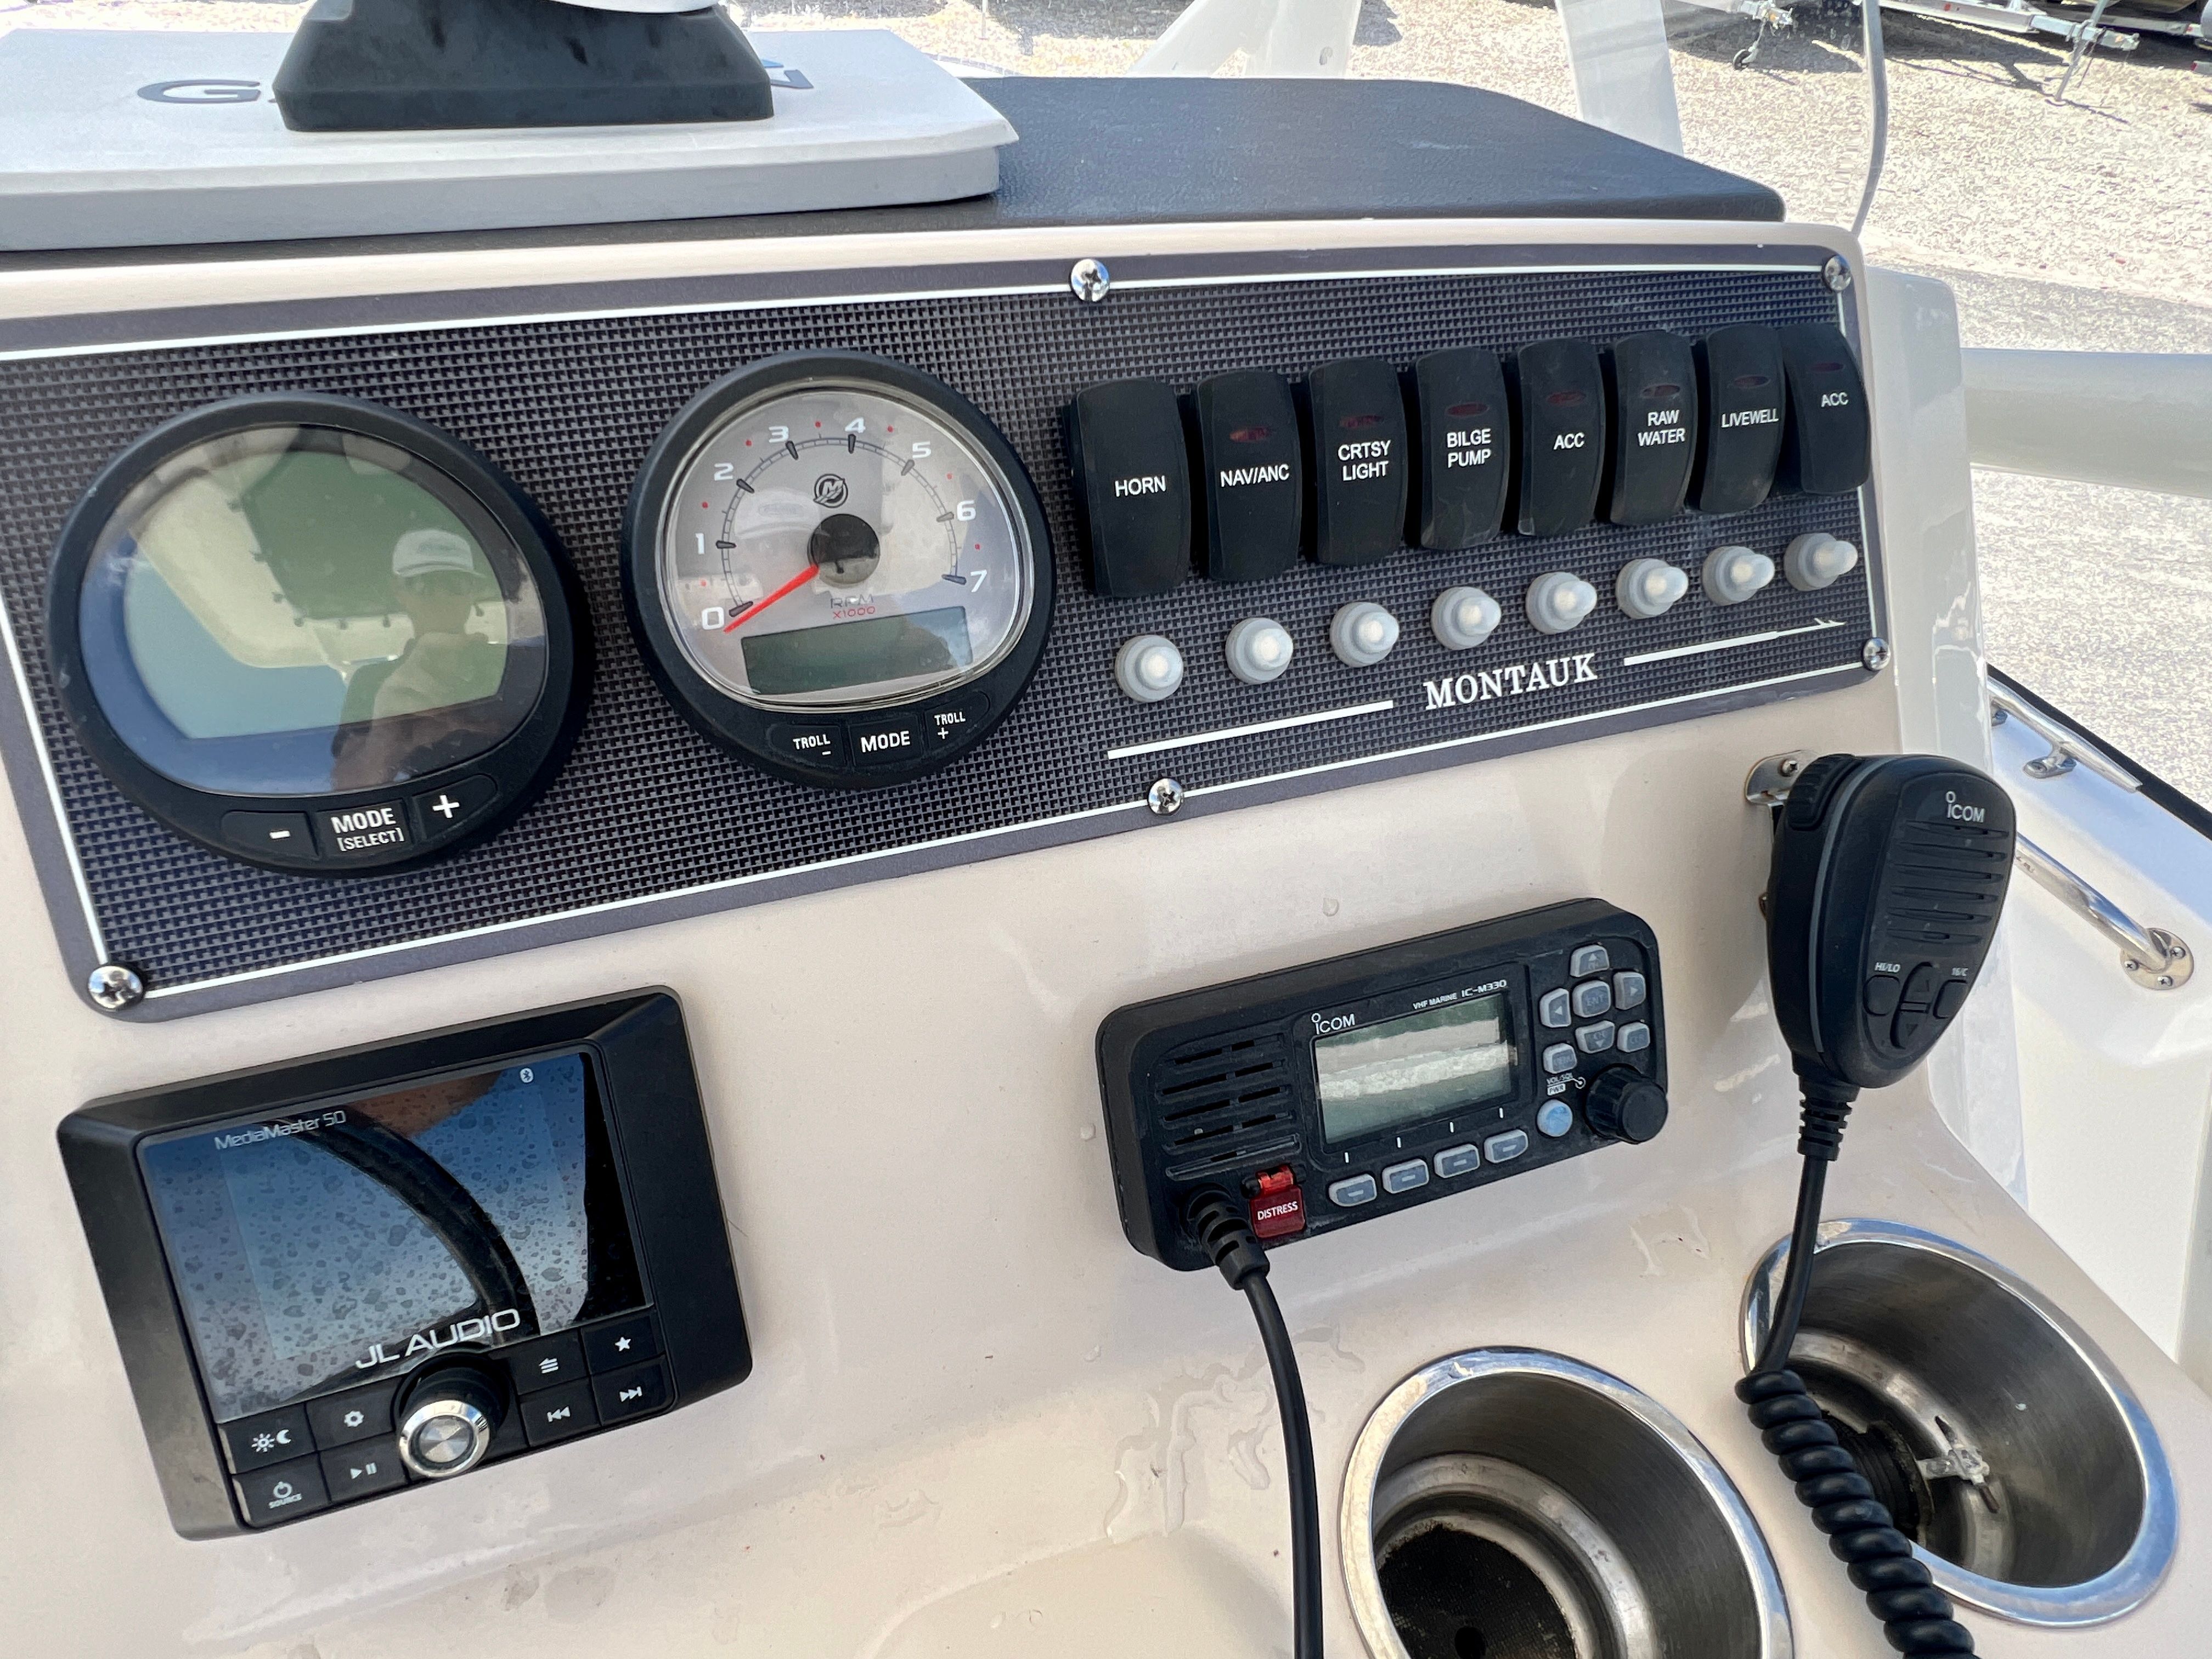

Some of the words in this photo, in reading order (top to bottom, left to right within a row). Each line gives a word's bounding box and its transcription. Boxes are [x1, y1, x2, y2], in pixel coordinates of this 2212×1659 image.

[1821, 392, 1849, 407] ACC
[845, 417, 866, 434] 4
[1647, 409, 1679, 427] RAW
[1721, 408, 1779, 428] LIVEWELL
[768, 425, 790, 443] 3
[1447, 428, 1492, 449] BILGE
[1553, 432, 1585, 450] ACC
[1638, 428, 1685, 447] WATER
[912, 442, 932, 459] 5
[1338, 440, 1391, 461] CRTSY
[1447, 449, 1492, 469] PUMP
[713, 463, 734, 482] 2
[1220, 464, 1290, 488] NAV/ANC
[1342, 461, 1389, 482] LIGHT
[1115, 475, 1167, 497] HORN
[957, 500, 977, 521] 6
[695, 532, 705, 554] 1
[969, 570, 989, 592] 7
[701, 607, 725, 630] 0
[1423, 652, 1598, 710] MONTAUK
[934, 711, 967, 726] TROLL
[792, 734, 831, 750] TROLL
[860, 730, 911, 753] MODE
[331, 808, 396, 833] MODE
[1413, 999, 1428, 1010] VHF
[1429, 992, 1458, 1005] MARINE
[1462, 979, 1507, 998] IC-M330
[1549, 1085, 1565, 1094] PWR
[215, 1118, 320, 1150] MediaMaster
[323, 1110, 347, 1127] 50
[1257, 1201, 1299, 1221] DISTRESS
[356, 1343, 400, 1369] JL
[405, 1308, 521, 1357] AUDIO
